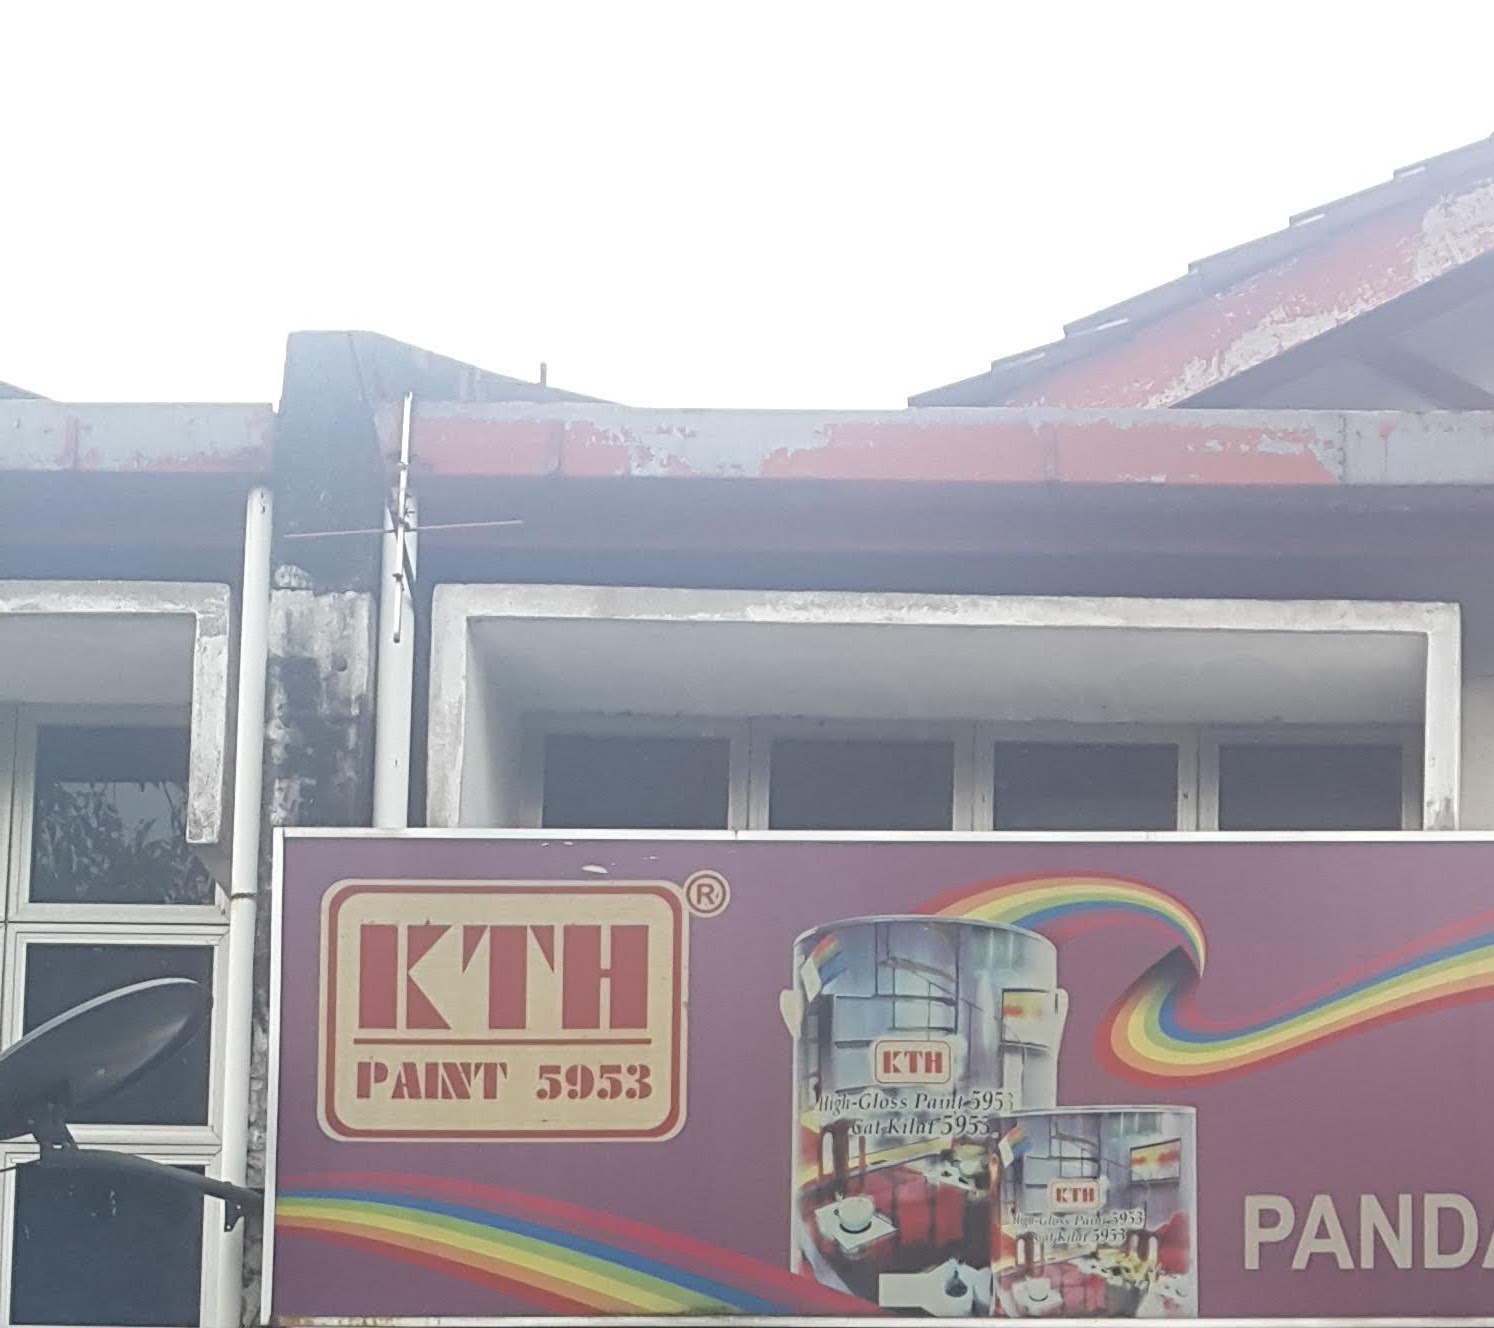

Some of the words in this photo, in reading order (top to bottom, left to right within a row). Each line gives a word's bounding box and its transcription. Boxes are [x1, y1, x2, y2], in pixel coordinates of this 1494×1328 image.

[358, 923, 649, 1031] KTH
[355, 1061, 508, 1101] PAINT
[535, 1061, 653, 1101] 5953
[883, 1050, 943, 1074] KTH
